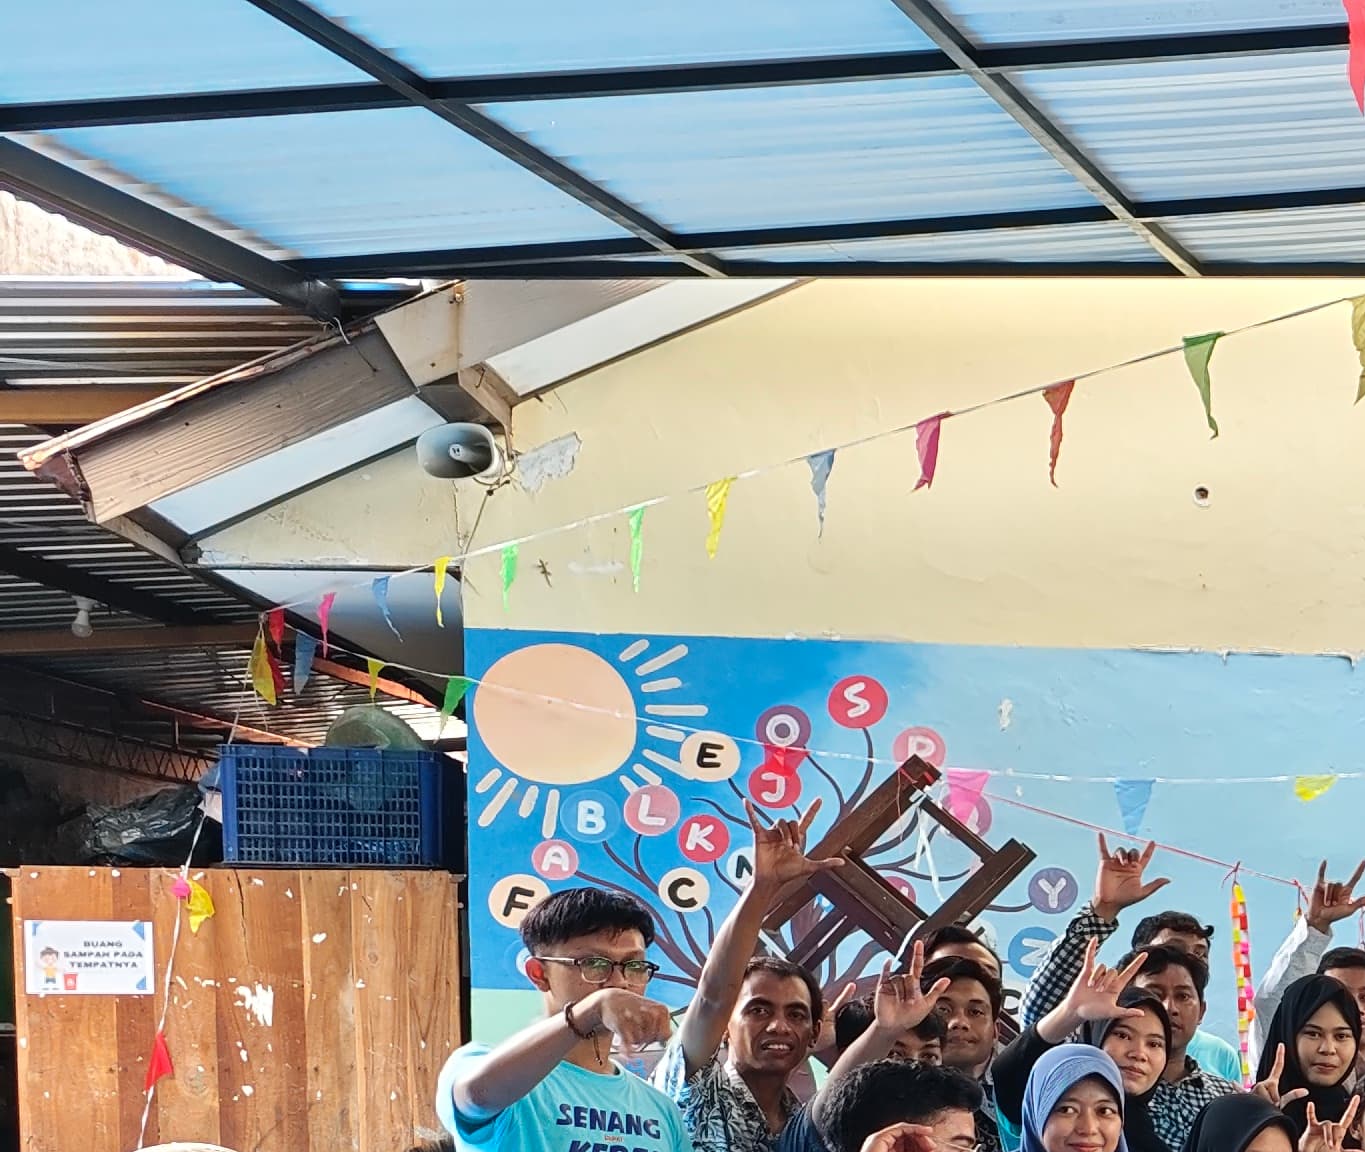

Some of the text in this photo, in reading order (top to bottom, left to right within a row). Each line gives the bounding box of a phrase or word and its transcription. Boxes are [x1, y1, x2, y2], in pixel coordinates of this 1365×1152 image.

[844, 681, 872, 718] S
[766, 713, 800, 747] O
[695, 741, 724, 768] E
[761, 769, 787, 802] J
[577, 800, 607, 835] B
[638, 793, 667, 828] L
[686, 822, 715, 853] K
[541, 845, 570, 872] A
[502, 886, 536, 918] F
[667, 876, 699, 910] C
[1038, 878, 1068, 909] Y
[83, 940, 123, 948] BUANG
[69, 961, 138, 969] TEMPATNYA
[556, 1103, 661, 1140] SENANG
